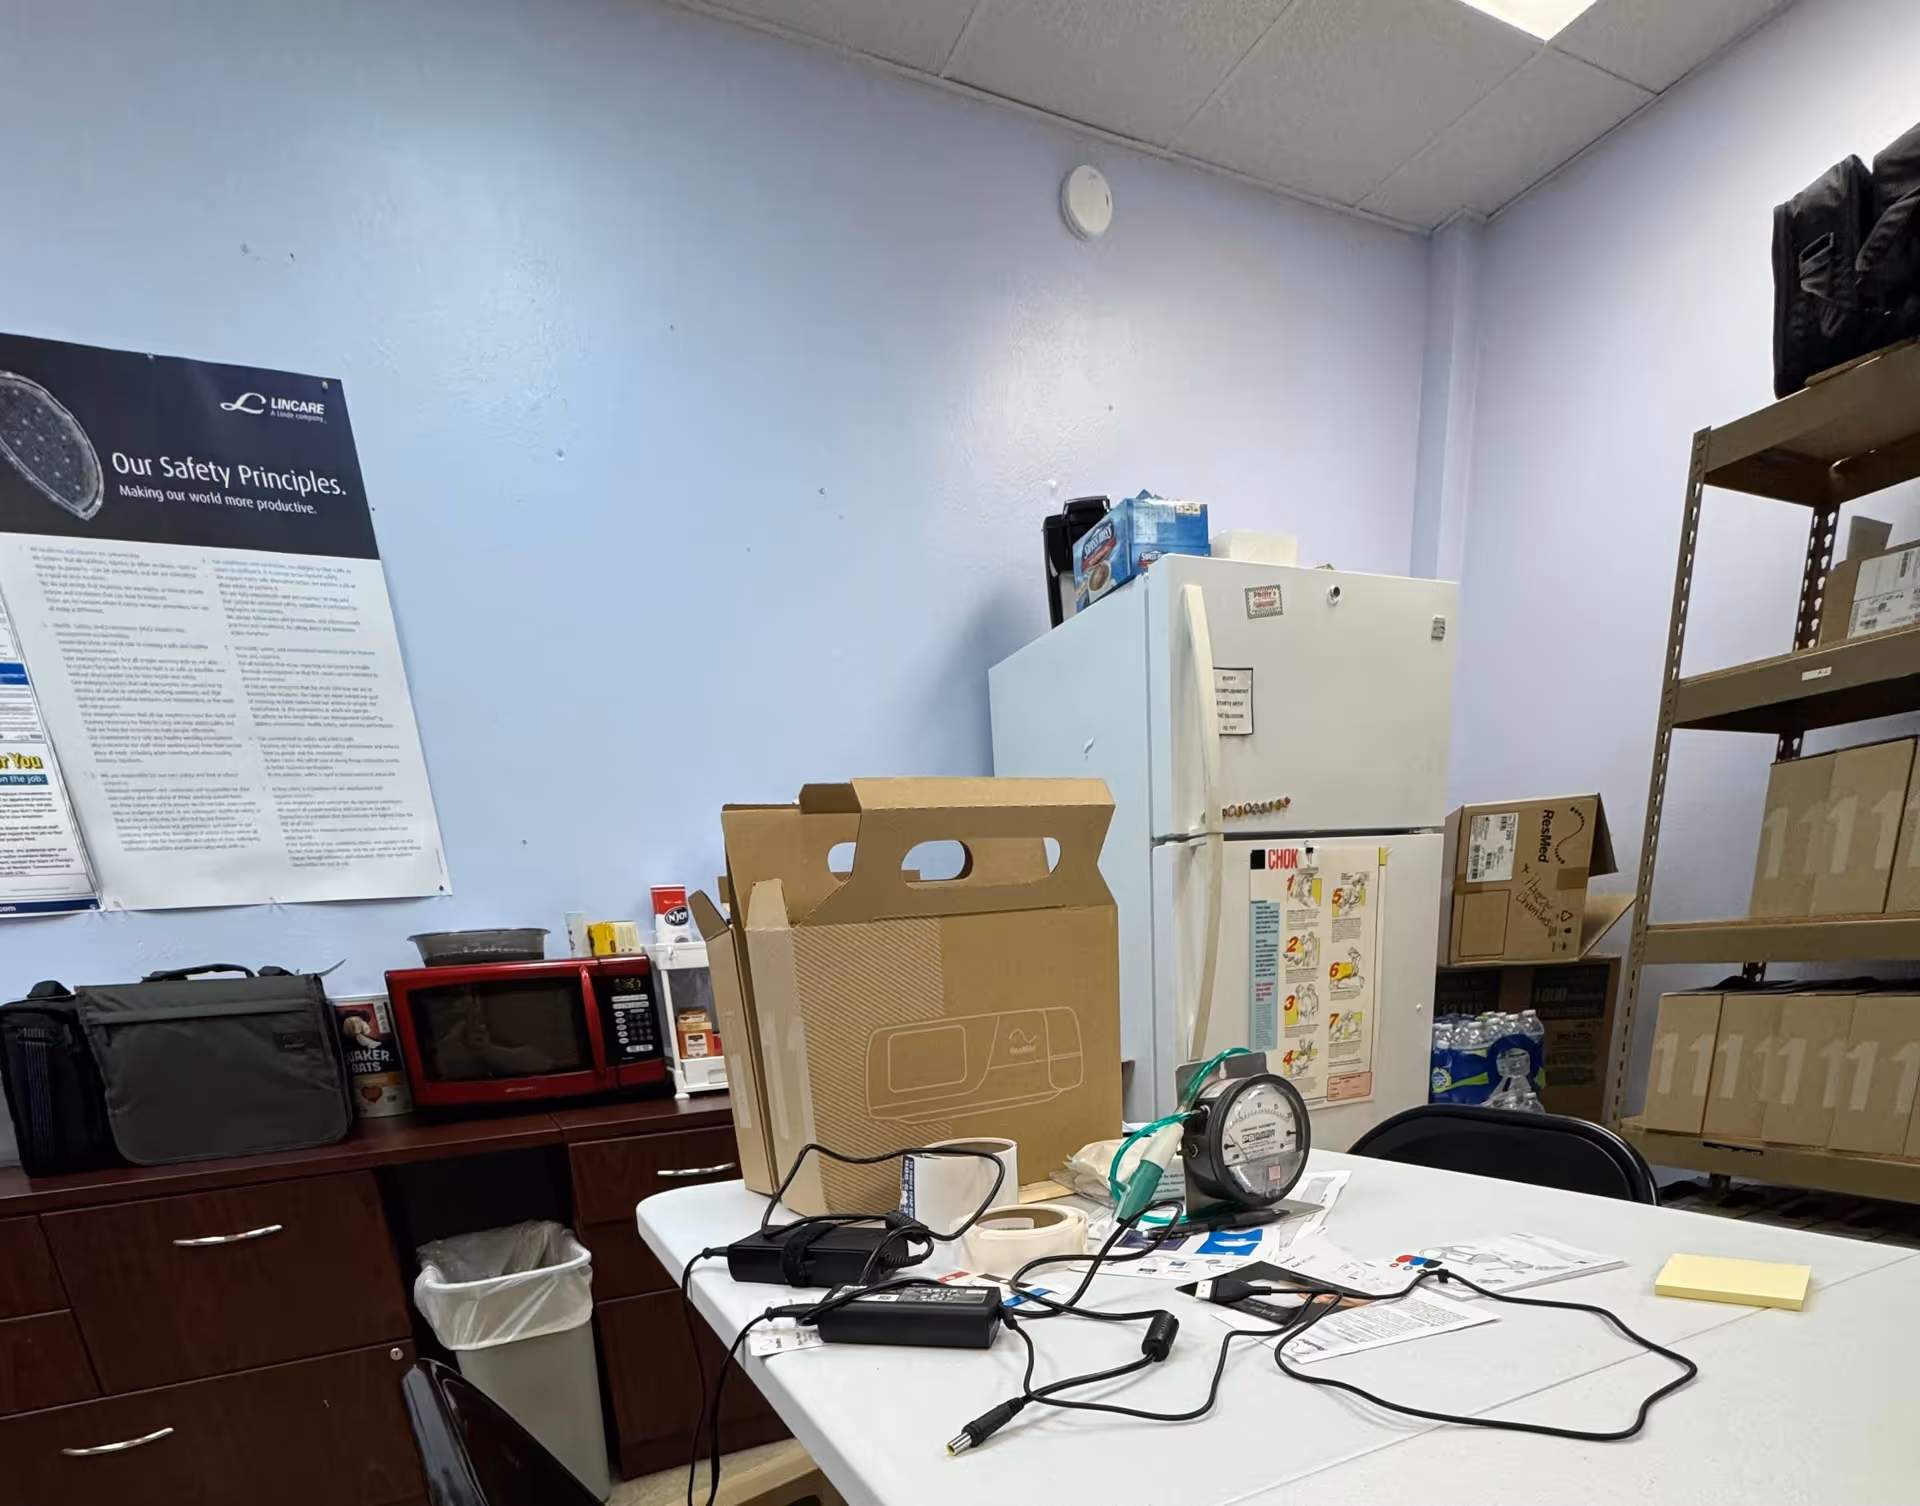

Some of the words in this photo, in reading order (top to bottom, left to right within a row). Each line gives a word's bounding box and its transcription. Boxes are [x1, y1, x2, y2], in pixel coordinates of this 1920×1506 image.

[271, 397, 325, 415] LINCARE
[279, 411, 294, 419] Linde
[112, 452, 152, 476] Our
[159, 456, 230, 488] Safety
[238, 464, 347, 497] Principles.
[119, 484, 164, 502] Making
[166, 489, 185, 501] our
[189, 491, 222, 505] world
[225, 495, 254, 508] more
[257, 499, 318, 514] productive.
[7, 752, 44, 770] You
[1537, 809, 1555, 863] ResMed
[1332, 888, 1342, 905] 5
[1286, 937, 1299, 952] 2
[1329, 962, 1339, 977] 6
[1284, 995, 1294, 1011] 3
[1330, 1013, 1339, 1028] 7
[1283, 1050, 1293, 1065] 4
